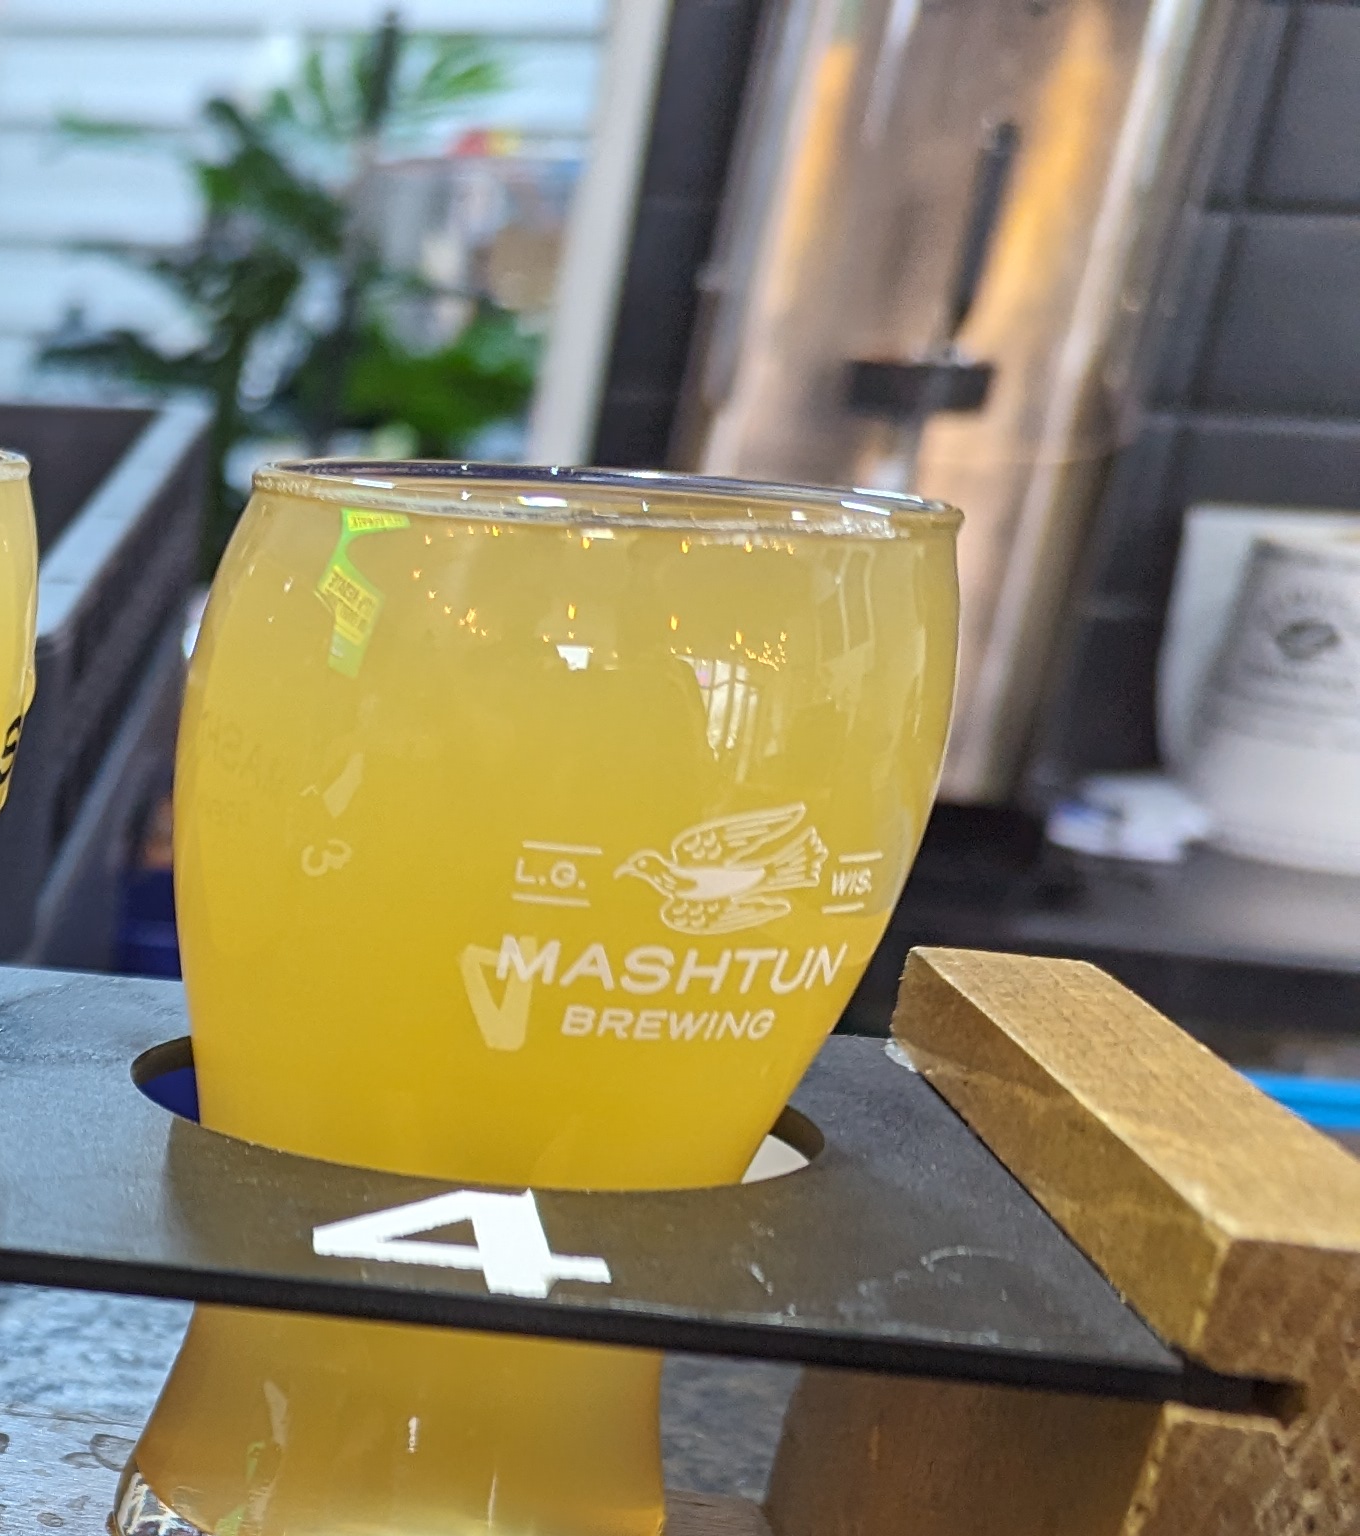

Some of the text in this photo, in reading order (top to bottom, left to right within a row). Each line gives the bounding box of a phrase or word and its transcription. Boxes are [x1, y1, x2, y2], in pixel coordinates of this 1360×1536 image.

[495, 933, 848, 995] MASHTUN
[560, 1004, 777, 1041] BREWING
[312, 1188, 612, 1299] 4
